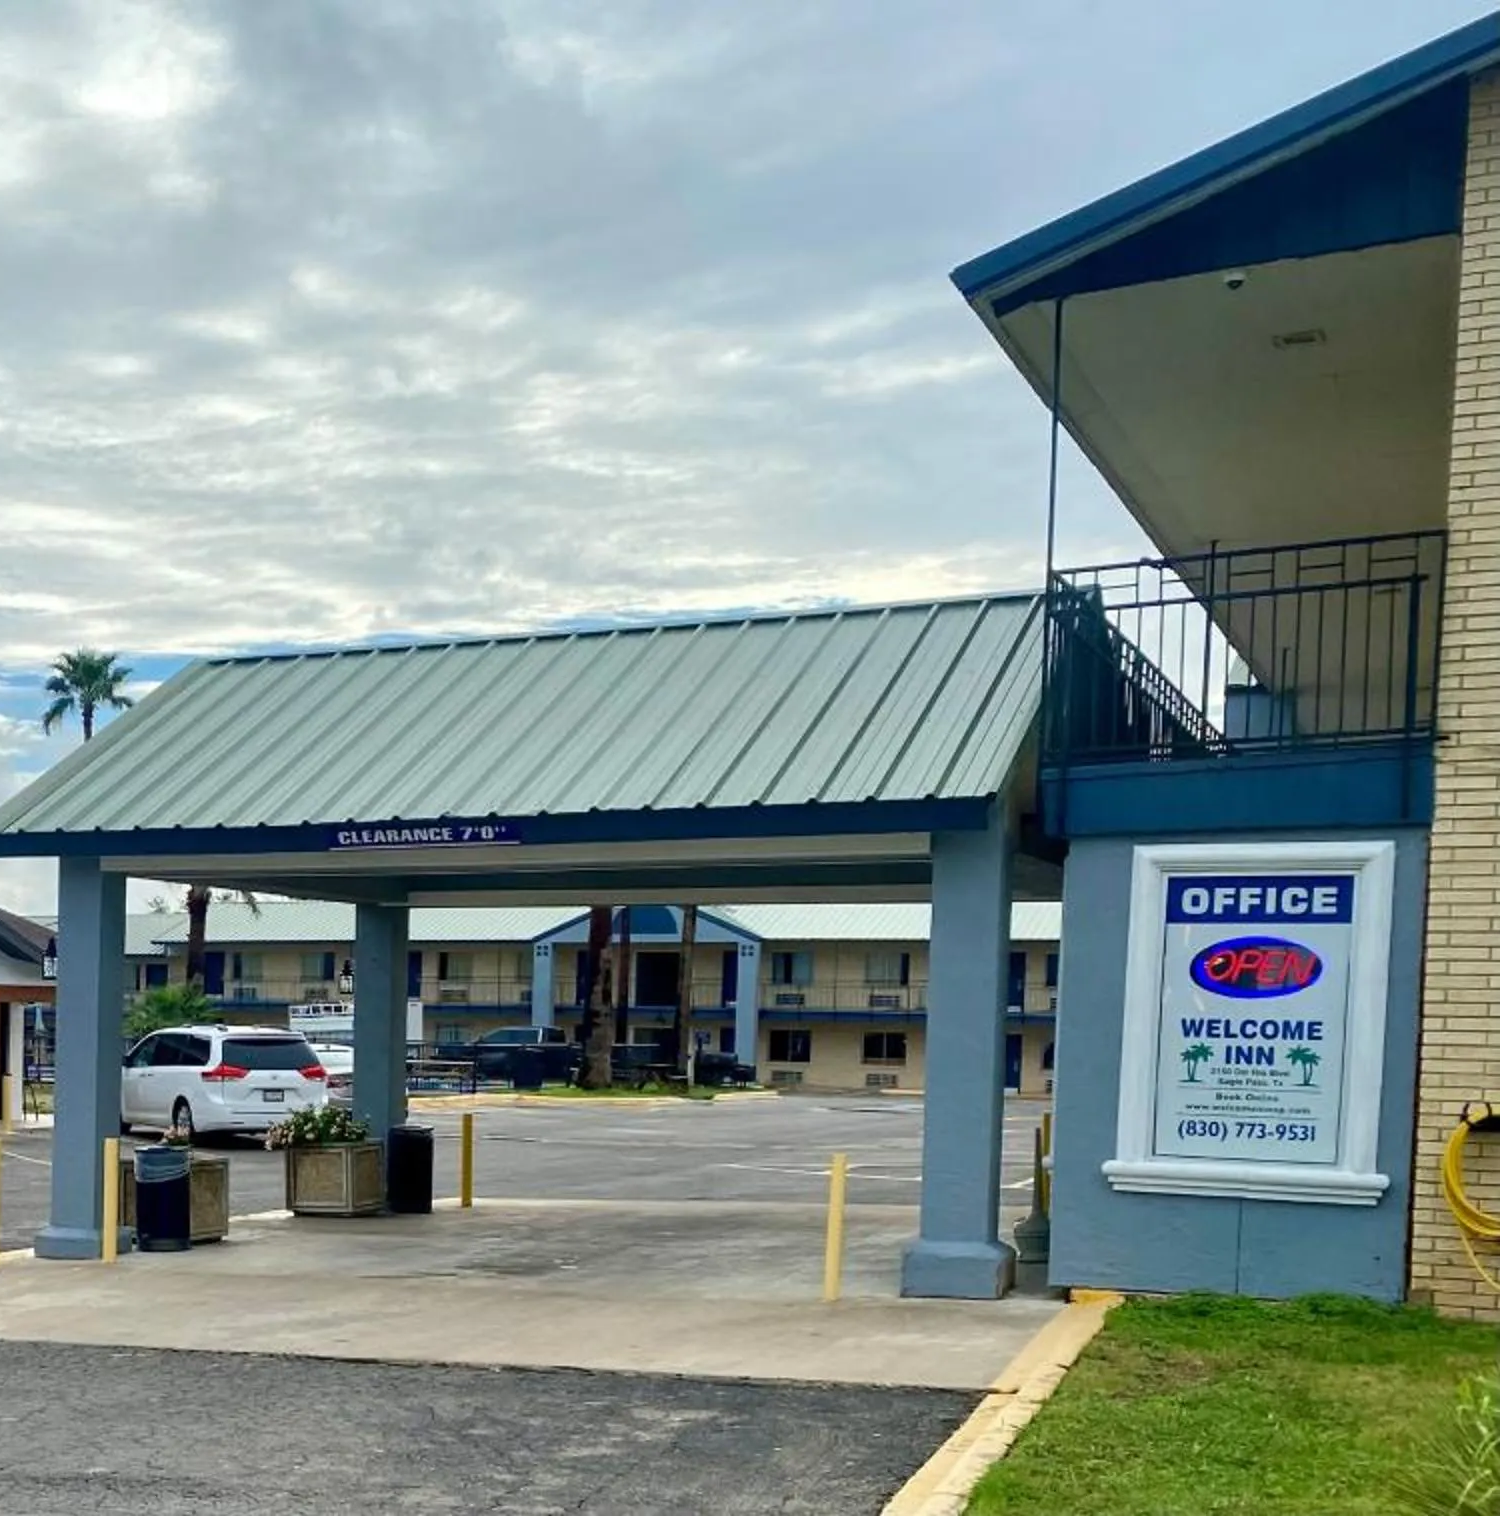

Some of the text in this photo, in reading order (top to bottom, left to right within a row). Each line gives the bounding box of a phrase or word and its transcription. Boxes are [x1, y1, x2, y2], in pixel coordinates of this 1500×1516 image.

[337, 827, 454, 845] CLEARANCE
[1181, 886, 1339, 915] OFFICE
[1206, 949, 1317, 986] OPEN
[1181, 1018, 1324, 1041] WELCOME
[1225, 1045, 1275, 1066] INN
[1215, 1091, 1240, 1101] Book
[1178, 1119, 1316, 1142] (830) 773-9531
